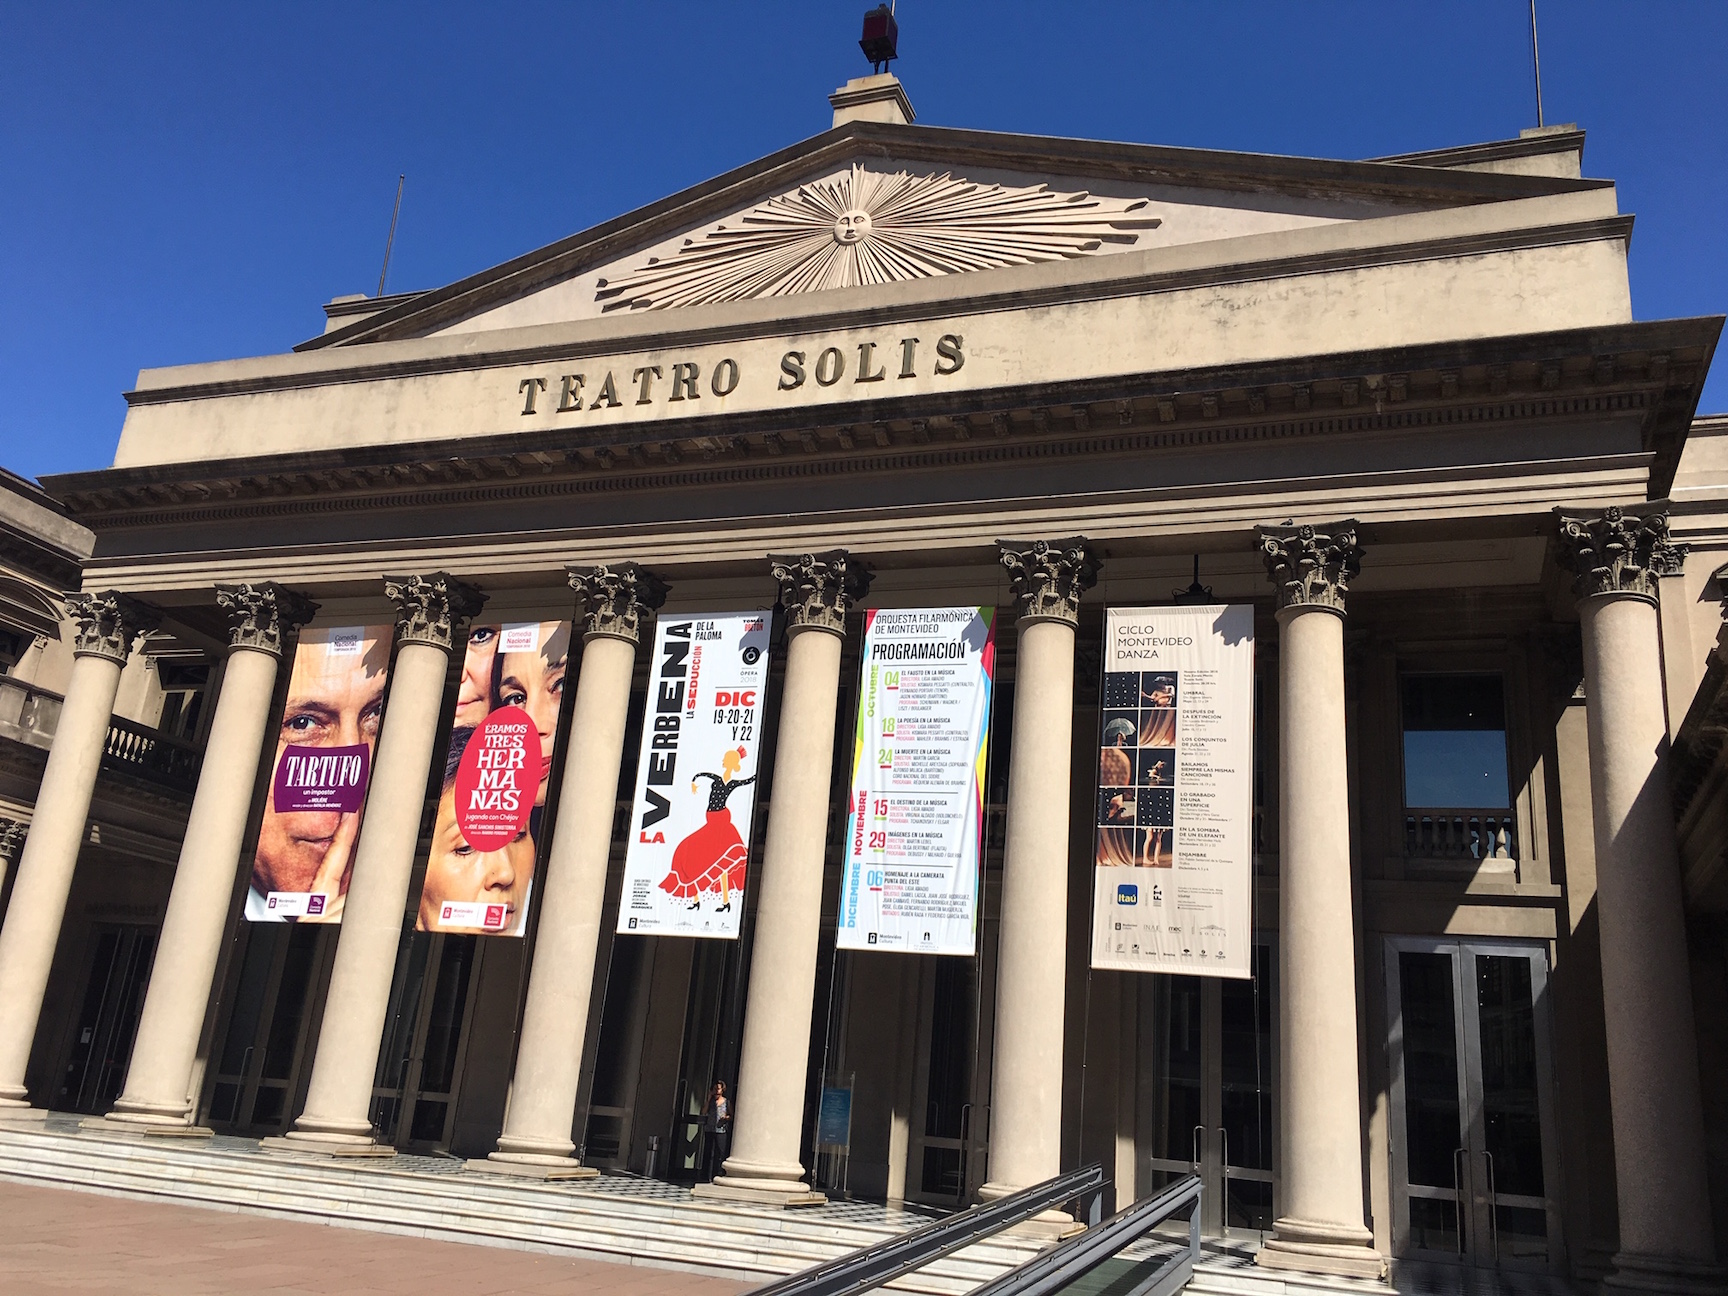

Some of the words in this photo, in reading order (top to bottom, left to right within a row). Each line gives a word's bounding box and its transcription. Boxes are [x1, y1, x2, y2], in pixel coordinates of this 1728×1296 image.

[520, 357, 740, 416] TEATRO
[777, 334, 964, 392] SOLIS
[697, 622, 705, 630] DE
[706, 621, 714, 630] LA
[876, 614, 917, 624] ORQUESTA
[919, 612, 974, 623] FILARMÓNICA
[695, 631, 722, 640] PALOMA
[875, 625, 886, 634] DE
[887, 624, 939, 634] MONTEVIDEO
[1118, 626, 1154, 635] CICLO
[873, 638, 965, 660] PROGRAMACIÓN
[1118, 637, 1193, 647] MONTEVIDEO
[1117, 650, 1159, 659] DANZA
[687, 646, 702, 710] SEDUCCIÓN
[884, 672, 899, 686] 04
[867, 664, 879, 718] OCTUBRE
[715, 691, 756, 707] DIC
[686, 711, 695, 719] LA
[714, 709, 753, 724] 19-20-21
[485, 723, 528, 734] ÉRAMOS
[642, 622, 692, 830] VERBENA
[882, 717, 895, 732] 18
[732, 726, 738, 741] Y
[740, 725, 752, 741] 22
[484, 734, 525, 748] TRES
[476, 748, 526, 768] HER
[878, 749, 892, 764] 24
[285, 754, 362, 787] TARTUFO
[477, 769, 517, 790] MA
[468, 790, 522, 811] NAS
[874, 800, 888, 816] 15
[465, 813, 488, 822] jugando
[500, 813, 519, 822] Chéjov
[854, 791, 867, 855] NOVIEMBRE
[640, 832, 665, 843] LA
[869, 832, 885, 848] 29
[867, 870, 883, 886] 06
[848, 863, 861, 928] DICIEMBRE
[1118, 894, 1136, 902] Itaú
